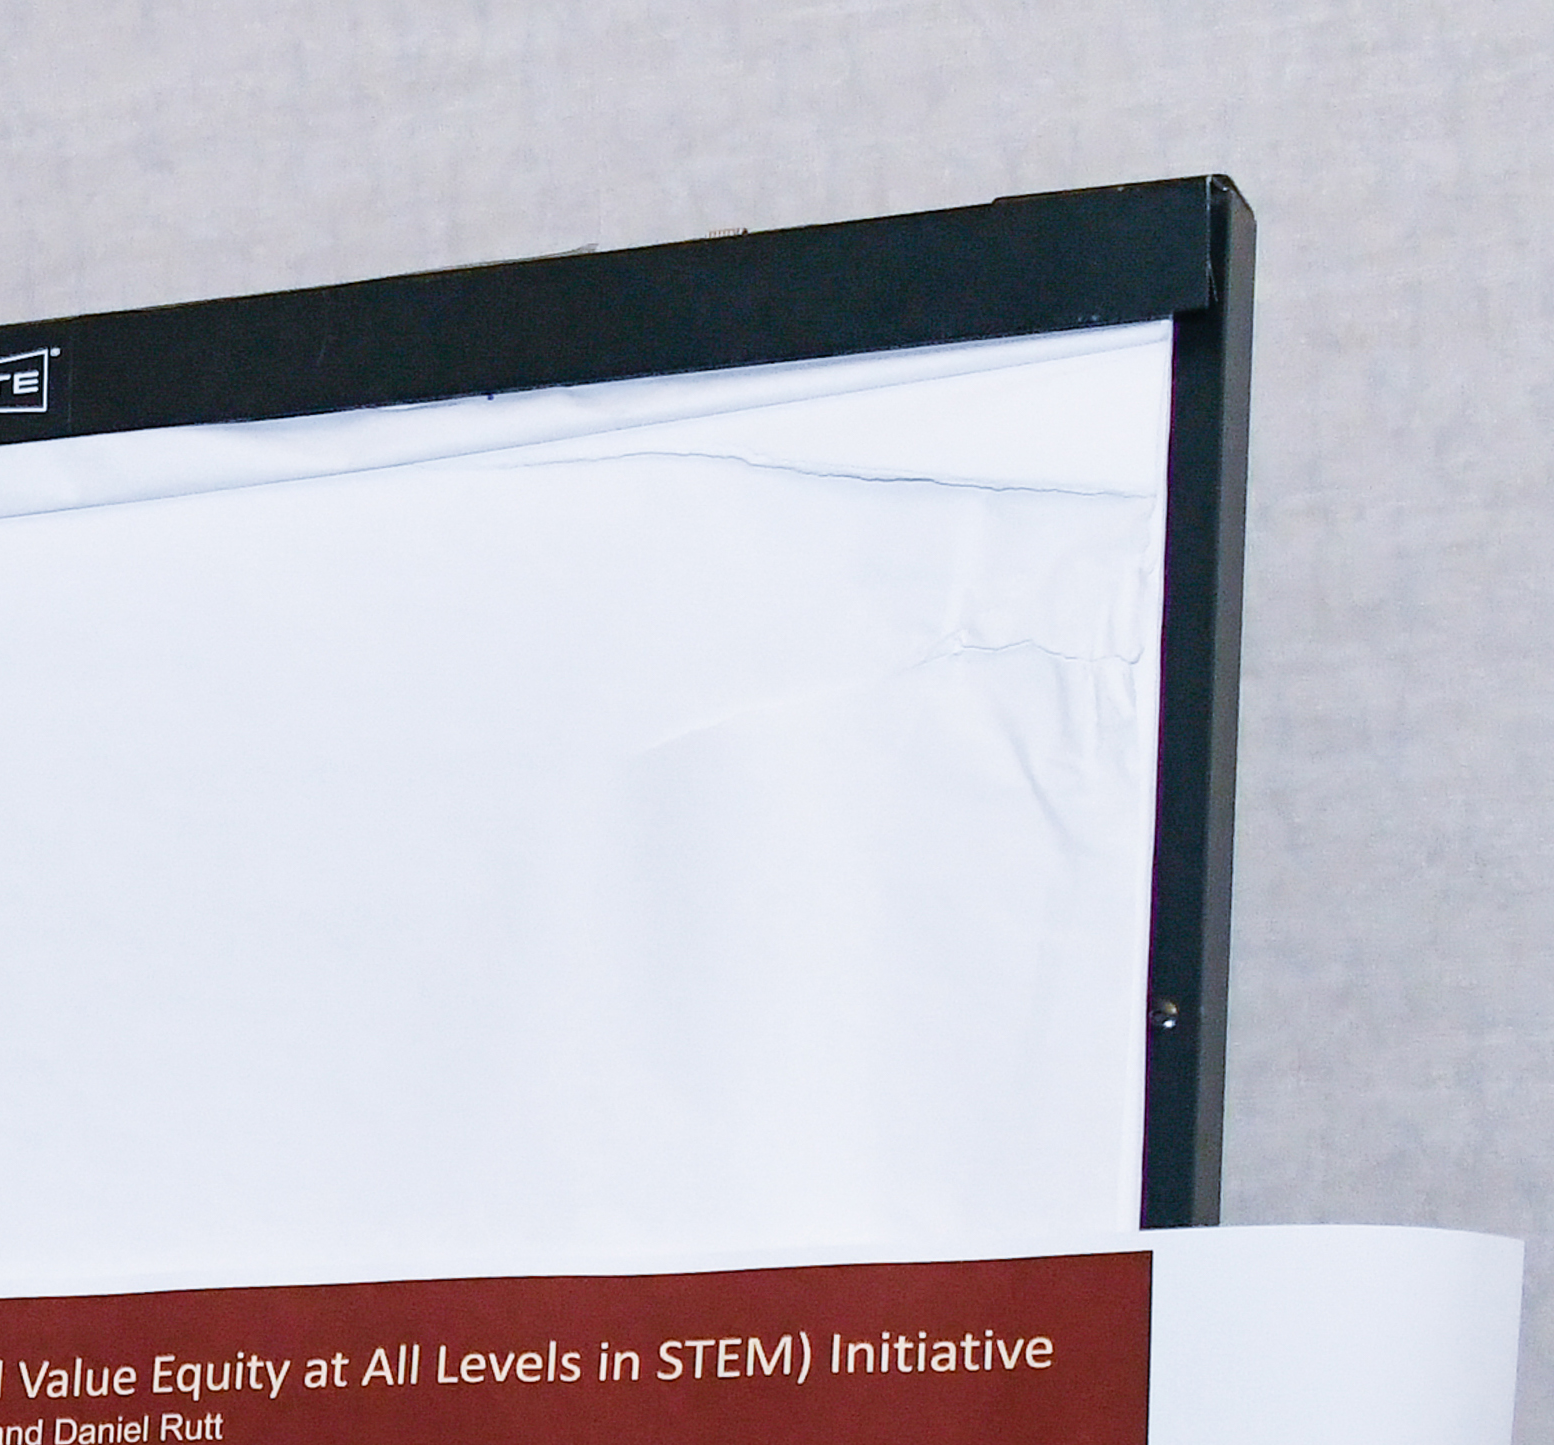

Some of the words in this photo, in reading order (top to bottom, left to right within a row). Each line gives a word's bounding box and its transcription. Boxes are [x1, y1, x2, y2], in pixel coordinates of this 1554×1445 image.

[19, 1357, 136, 1398] Value
[153, 1351, 290, 1401] Equity
[304, 1352, 349, 1388] at
[361, 1344, 419, 1386] All
[438, 1340, 581, 1383] Levels
[599, 1342, 639, 1381] in
[657, 1331, 811, 1384] STEM)
[832, 1330, 1053, 1373] Initiative
[55, 1415, 149, 1445] Daniel
[160, 1413, 223, 1441] Rutt
